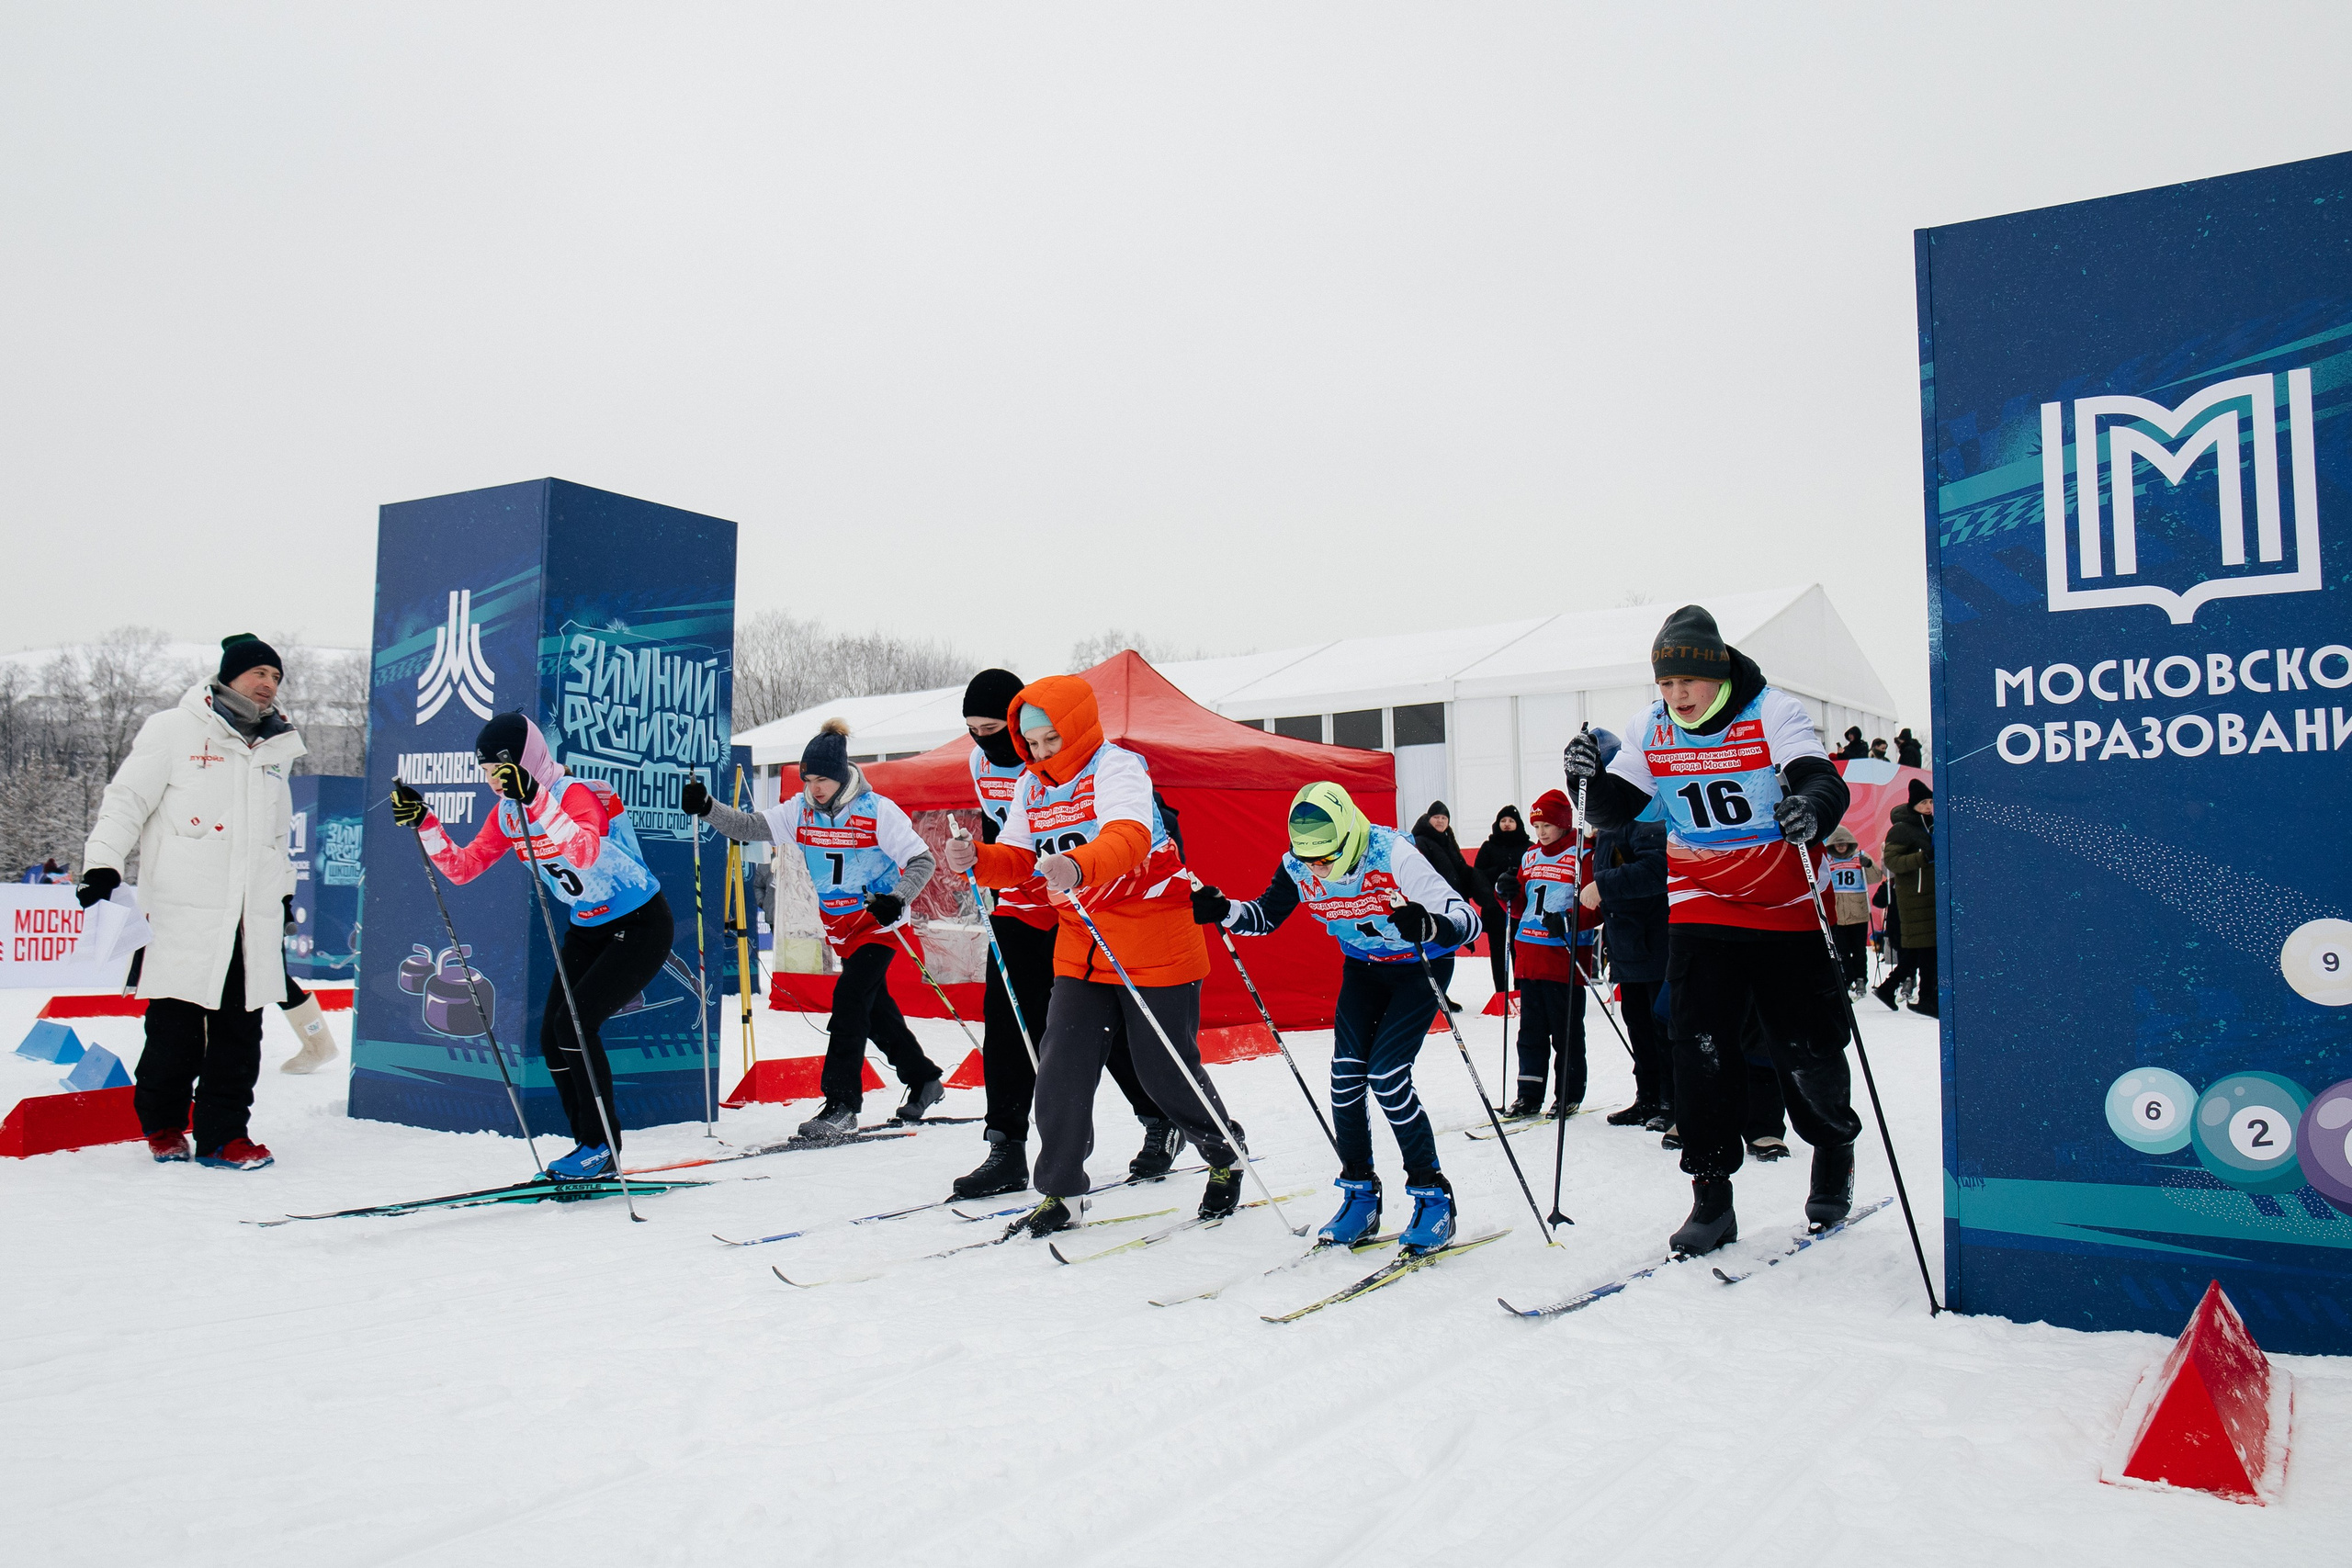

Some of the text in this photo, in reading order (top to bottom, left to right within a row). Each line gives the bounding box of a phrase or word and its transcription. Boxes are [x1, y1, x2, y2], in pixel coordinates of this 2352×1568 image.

[565, 634, 718, 719] ЗИМНИЙ
[1995, 644, 2352, 708] МОСКОВСКО
[398, 750, 489, 785] МОСКОВСК
[1647, 751, 1696, 763] Федерация
[1697, 750, 1737, 761] лыжных
[1670, 759, 1742, 773] города Москвы
[1678, 779, 1754, 829] 16
[667, 813, 704, 831] СПОРА
[540, 863, 583, 897] 5
[825, 852, 844, 886] 7
[1836, 871, 1856, 886] 18
[1533, 884, 1547, 917] 1
[14, 936, 79, 962] СПОРТ
[1088, 925, 1115, 963] NORDWAY
[2322, 952, 2341, 973] 9
[1279, 1042, 1294, 1066] SPORT
[2144, 1100, 2163, 1121] 6
[2246, 1118, 2275, 1148] 2
[581, 1149, 611, 1168] SPINE
[1340, 1181, 1364, 1190] SPINE
[1430, 1211, 1450, 1235] SPINE
